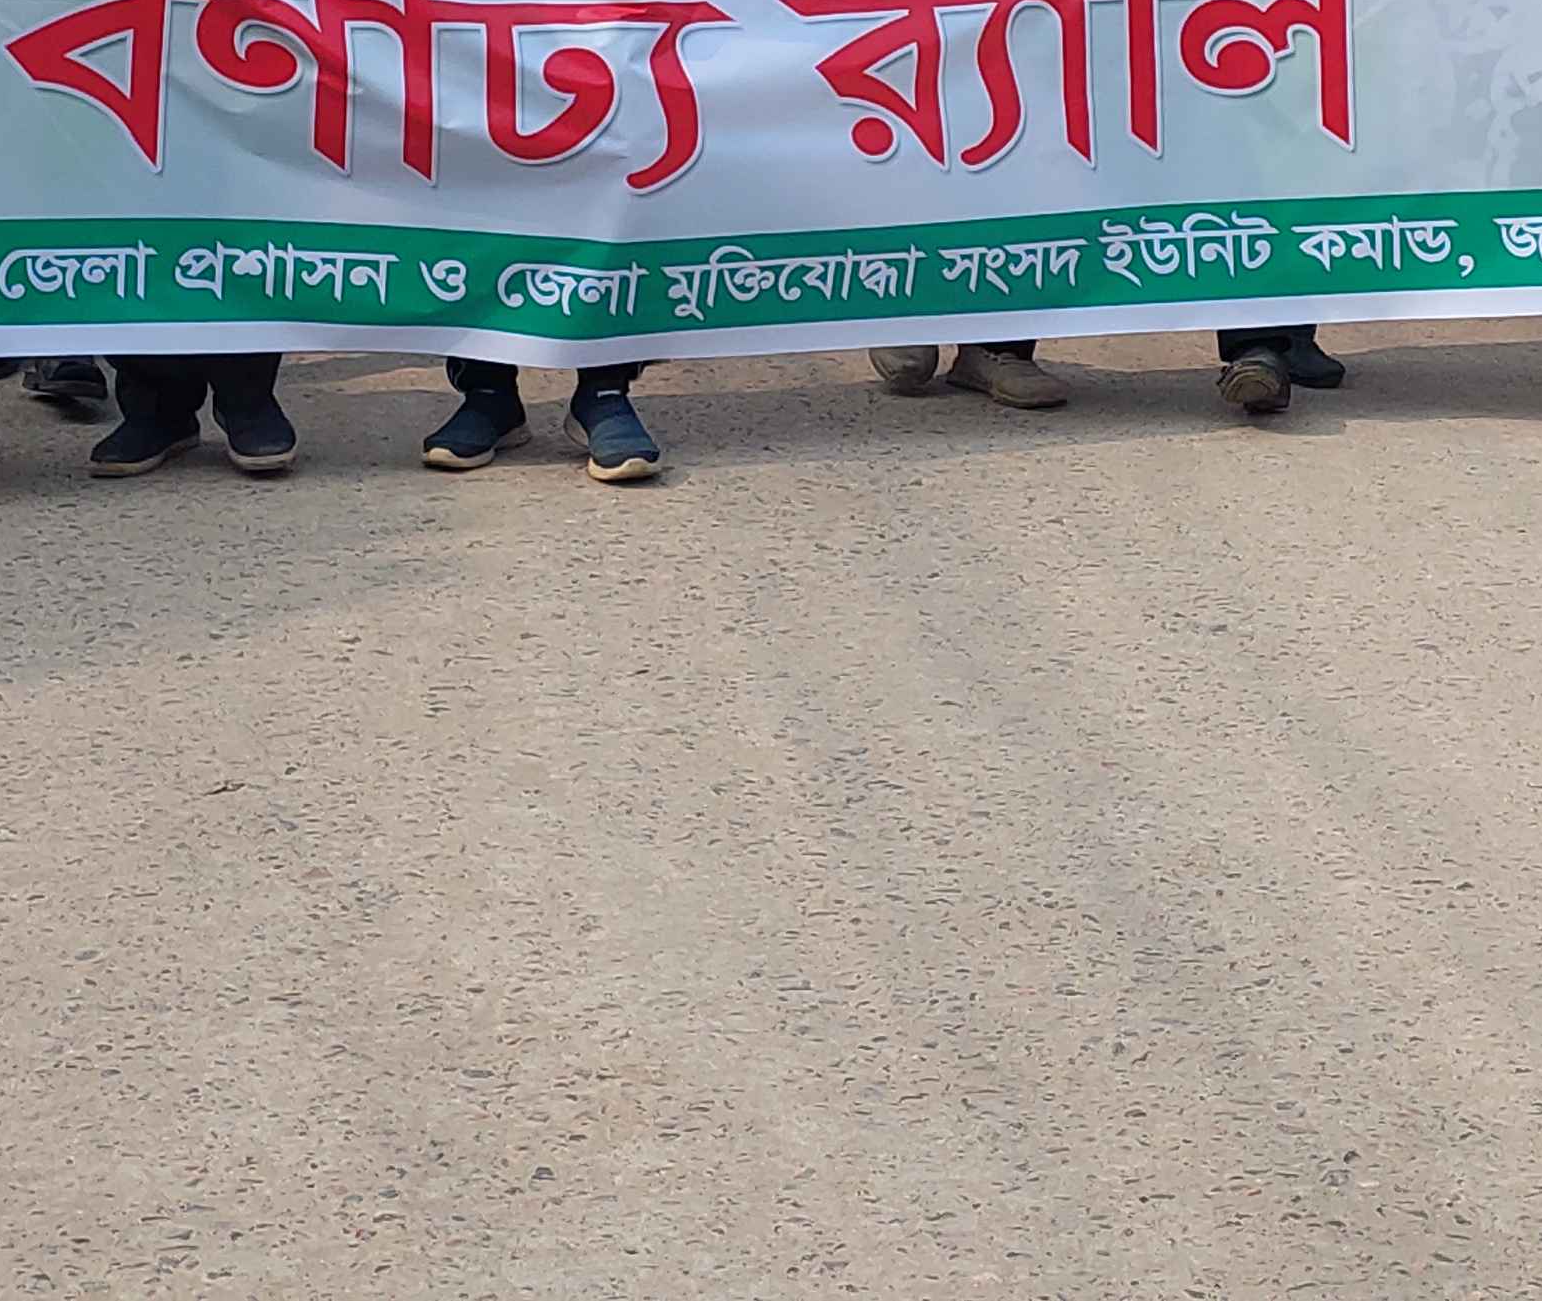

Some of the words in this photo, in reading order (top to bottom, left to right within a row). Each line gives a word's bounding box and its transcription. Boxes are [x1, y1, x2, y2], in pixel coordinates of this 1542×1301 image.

[173, 239, 399, 307] প্রশাসন
[420, 258, 467, 303] ও
[496, 260, 651, 318] জেলা
[664, 243, 928, 322] মুক্তিযোদ্ধা
[939, 236, 1088, 298] সংসদ
[1098, 211, 1276, 287] ইউনিট
[1290, 214, 1477, 280] কমান্ড,
